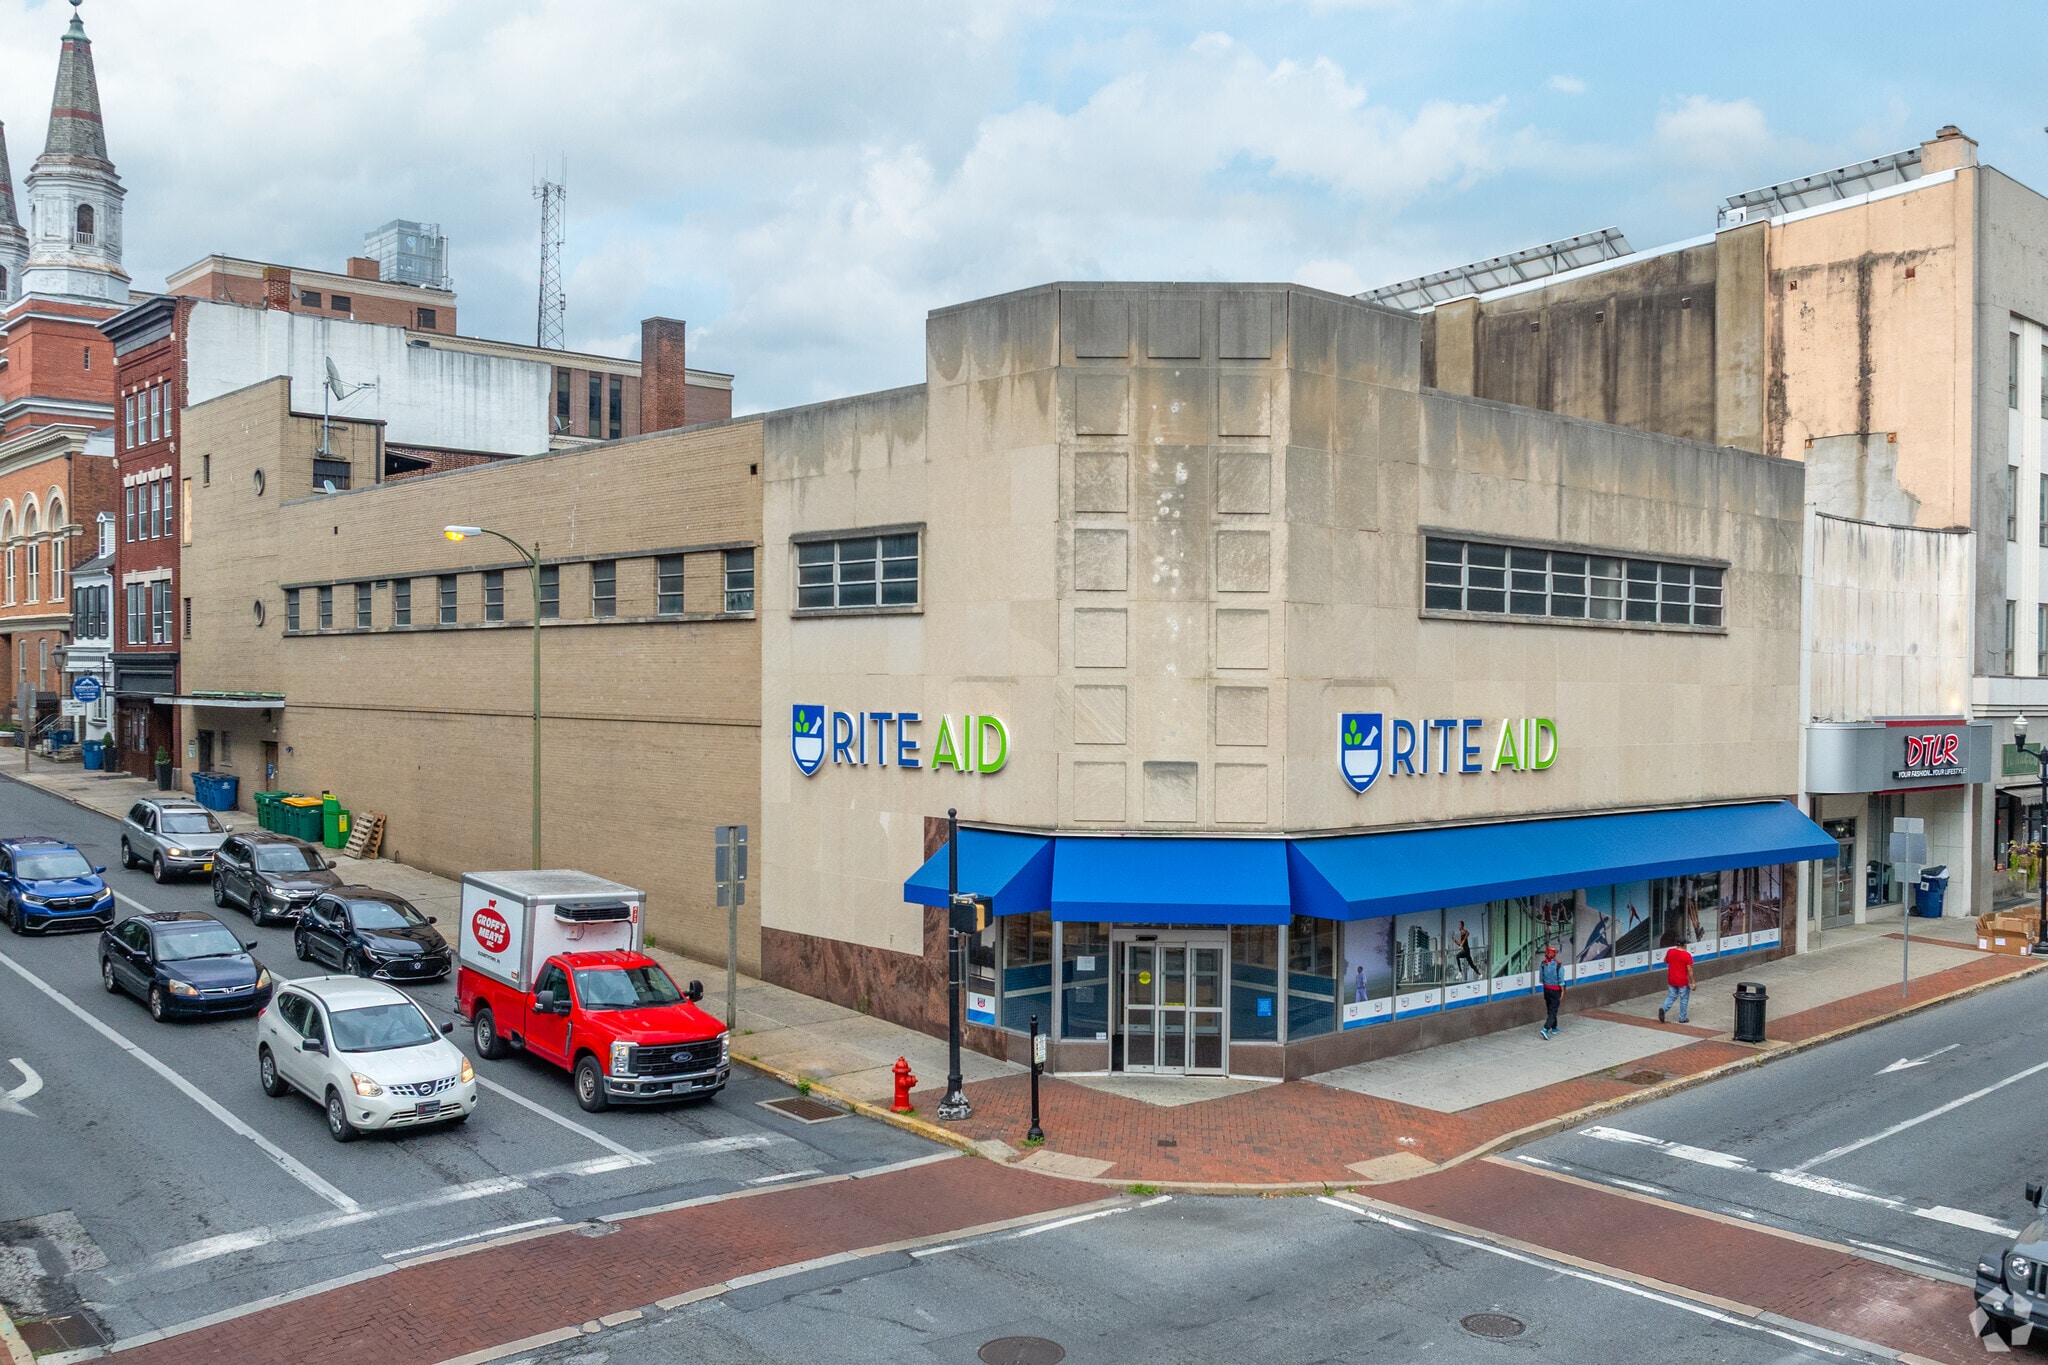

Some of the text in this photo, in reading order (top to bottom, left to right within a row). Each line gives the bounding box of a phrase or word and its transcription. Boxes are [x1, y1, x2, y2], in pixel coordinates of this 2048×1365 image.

[832, 711, 1011, 774] RITE AID
[1389, 718, 1559, 776] RITE AID
[1907, 733, 1959, 766] DTLR
[1898, 770, 1911, 778] YOUR
[476, 914, 506, 933] GROFF'S
[478, 927, 503, 944] MEATS
